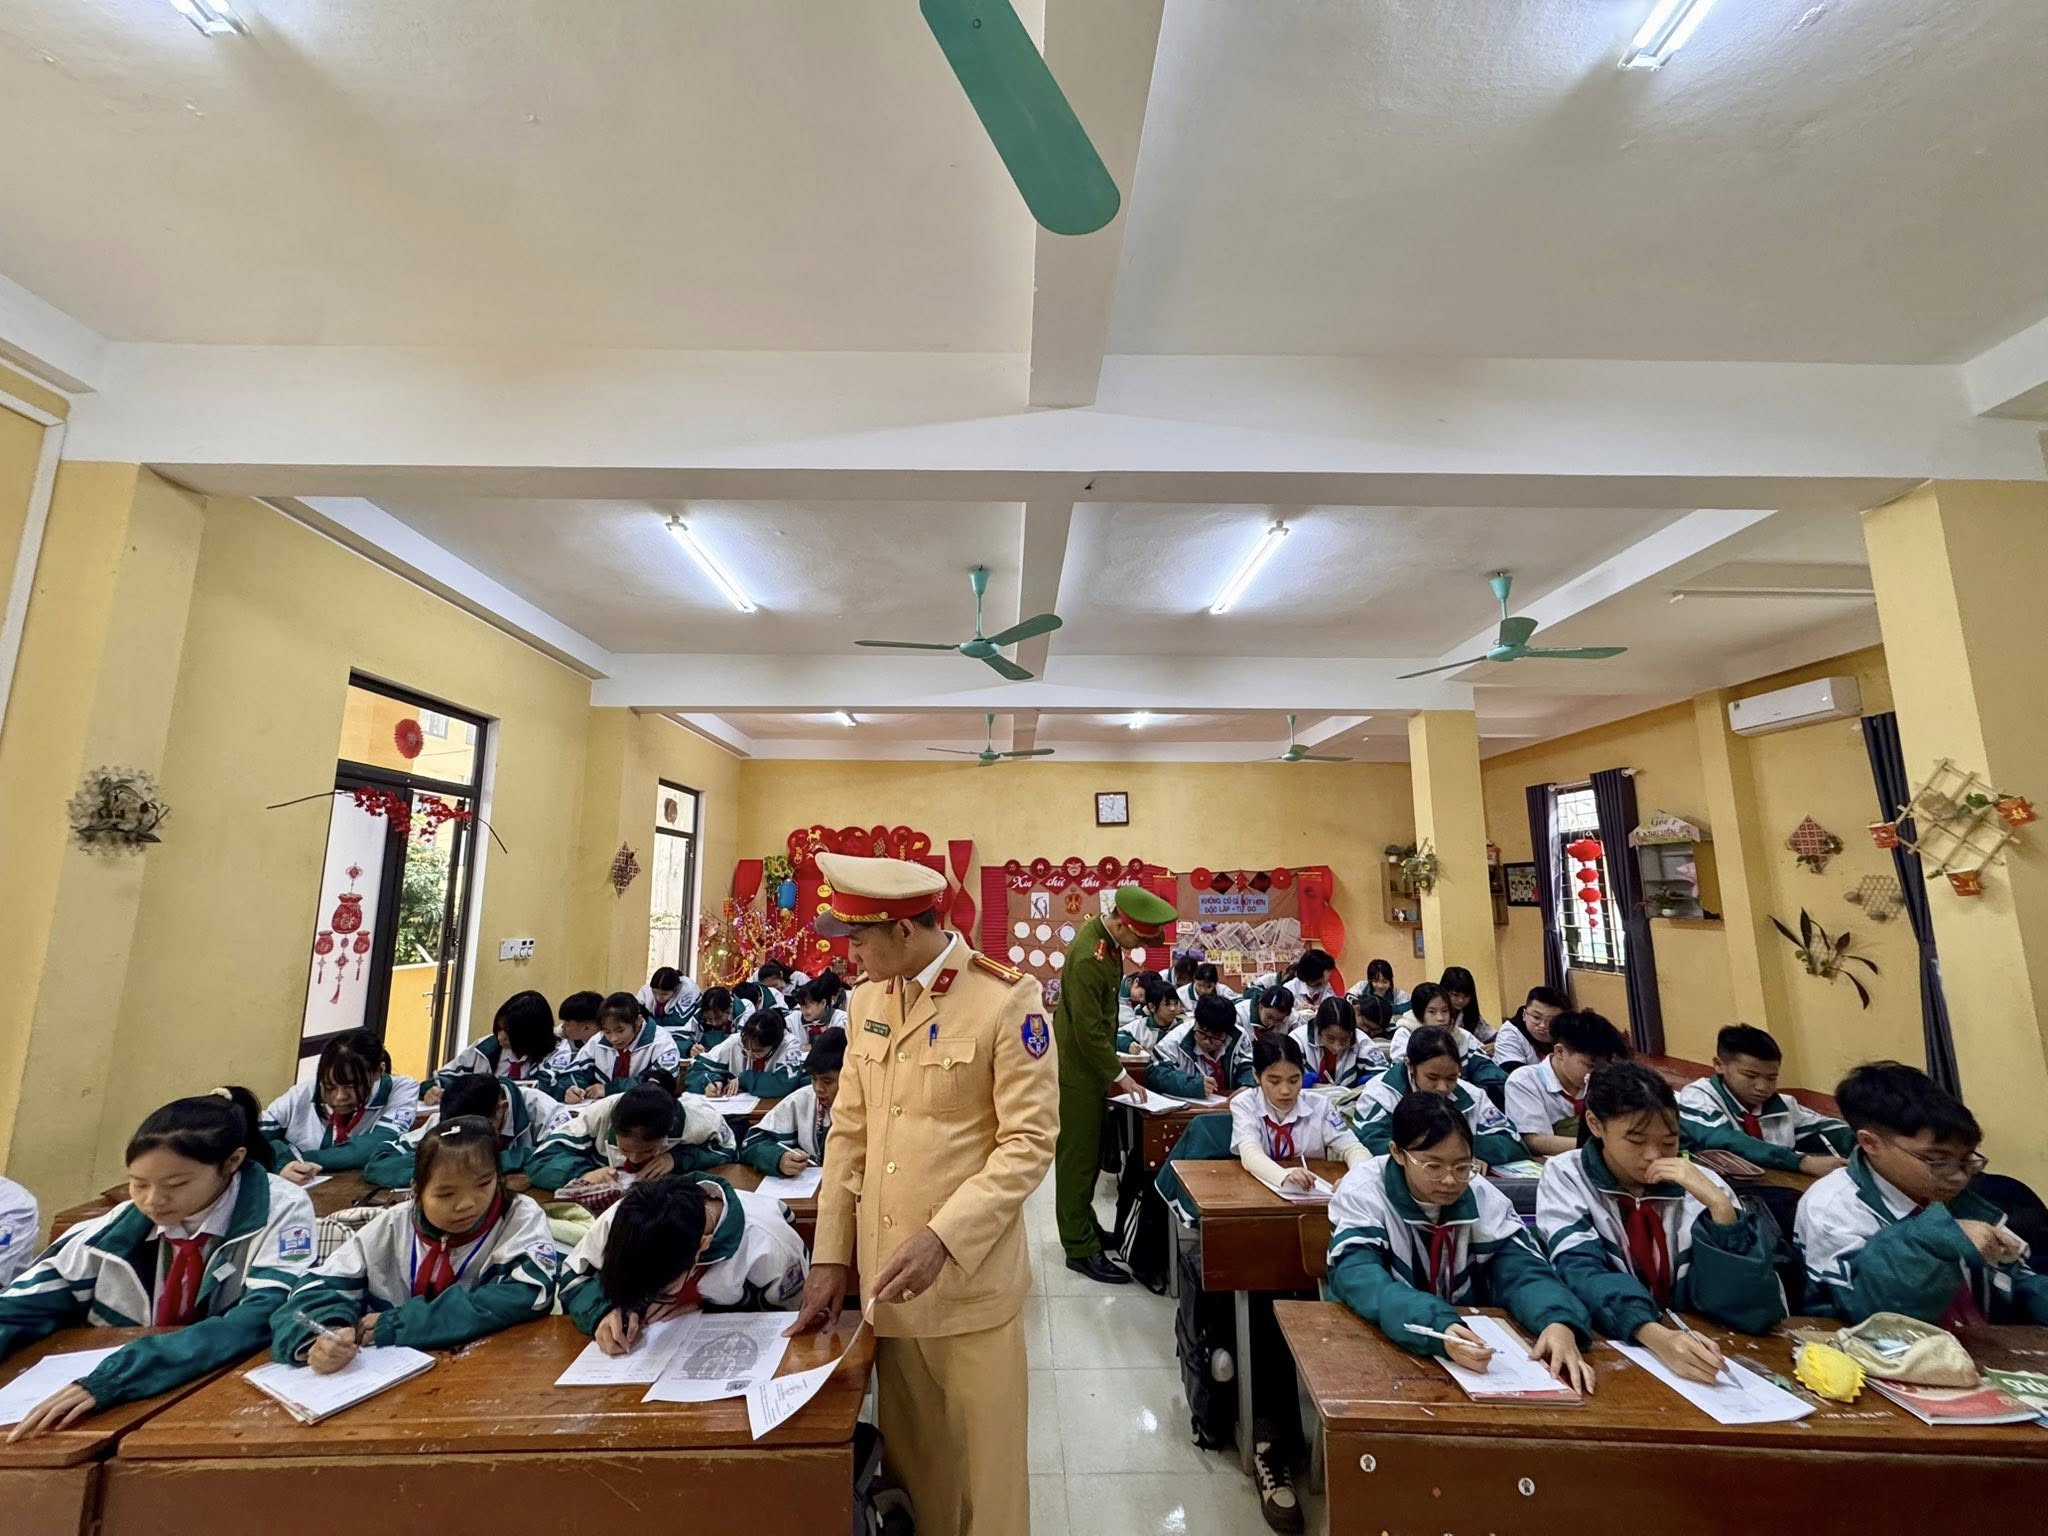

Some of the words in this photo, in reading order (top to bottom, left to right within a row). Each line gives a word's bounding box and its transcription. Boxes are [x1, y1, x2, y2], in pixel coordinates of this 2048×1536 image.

[1011, 875, 1033, 889] Xin
[1045, 875, 1066, 887] chữ
[1200, 896, 1221, 905] KHÔNG
[1204, 906, 1218, 914] ĐỘC
